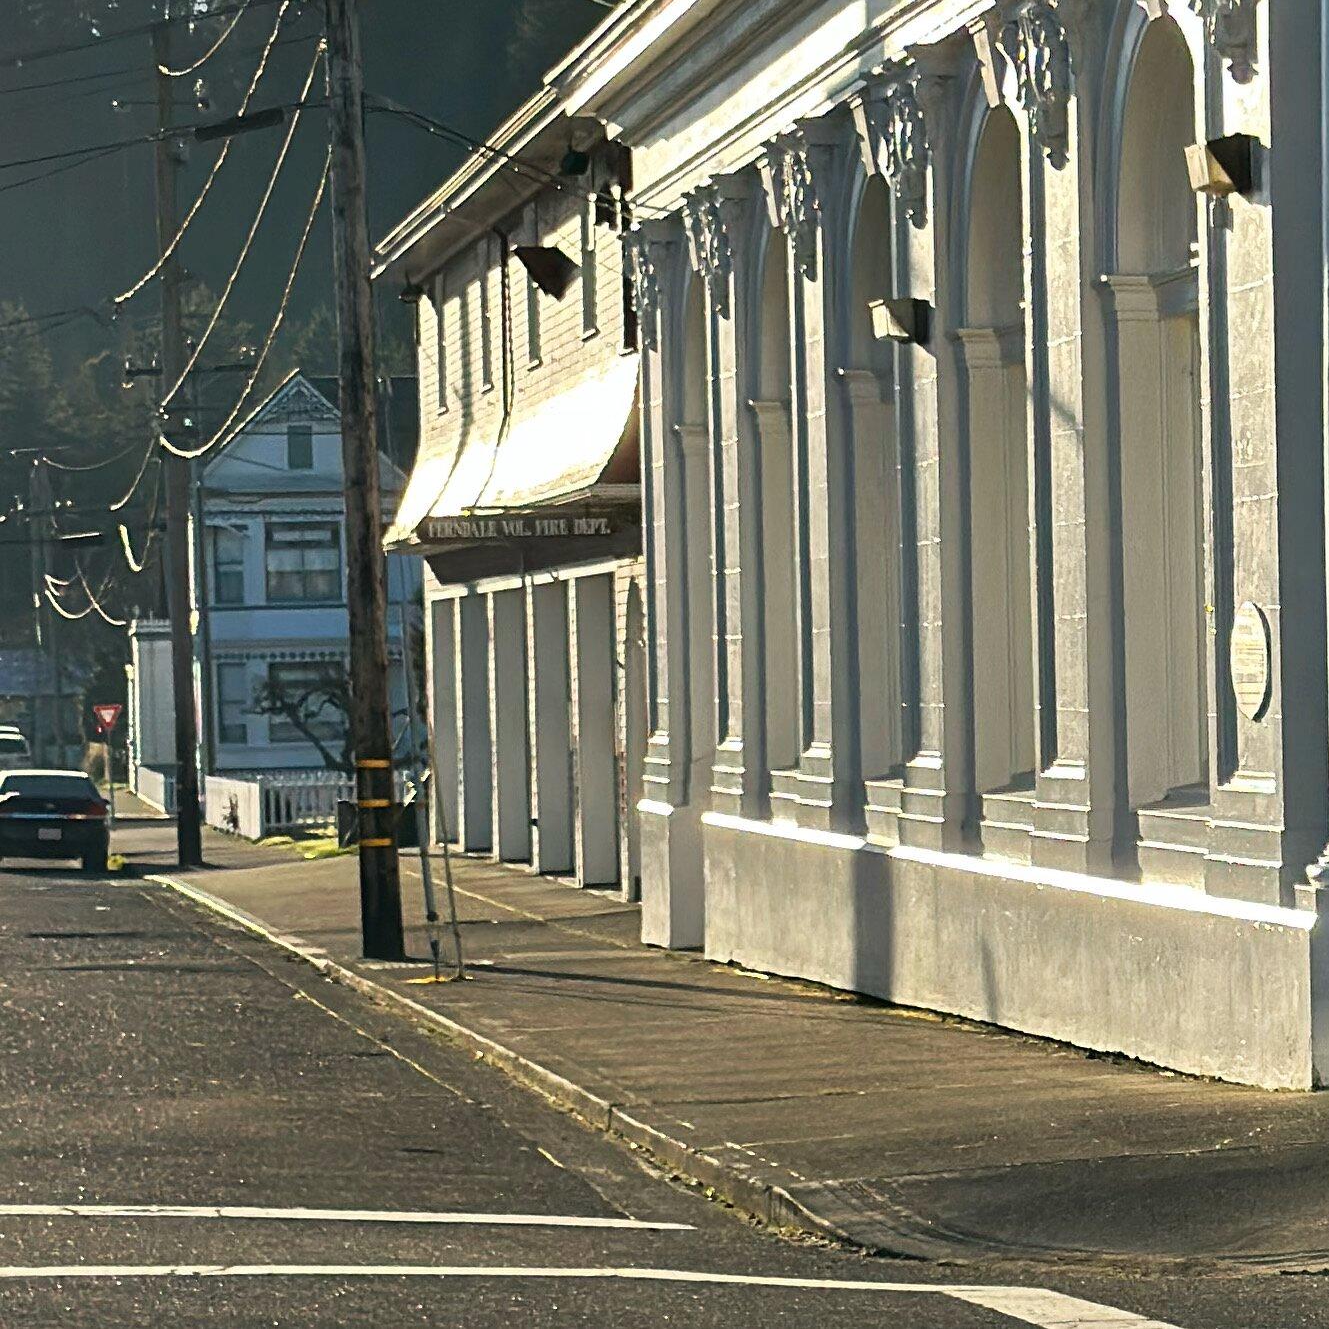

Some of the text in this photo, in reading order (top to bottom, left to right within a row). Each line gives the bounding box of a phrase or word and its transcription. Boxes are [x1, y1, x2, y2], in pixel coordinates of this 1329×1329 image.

[429, 522, 497, 538] FERNDALE
[535, 520, 567, 535] FIRE
[573, 517, 611, 535] DEPT.
